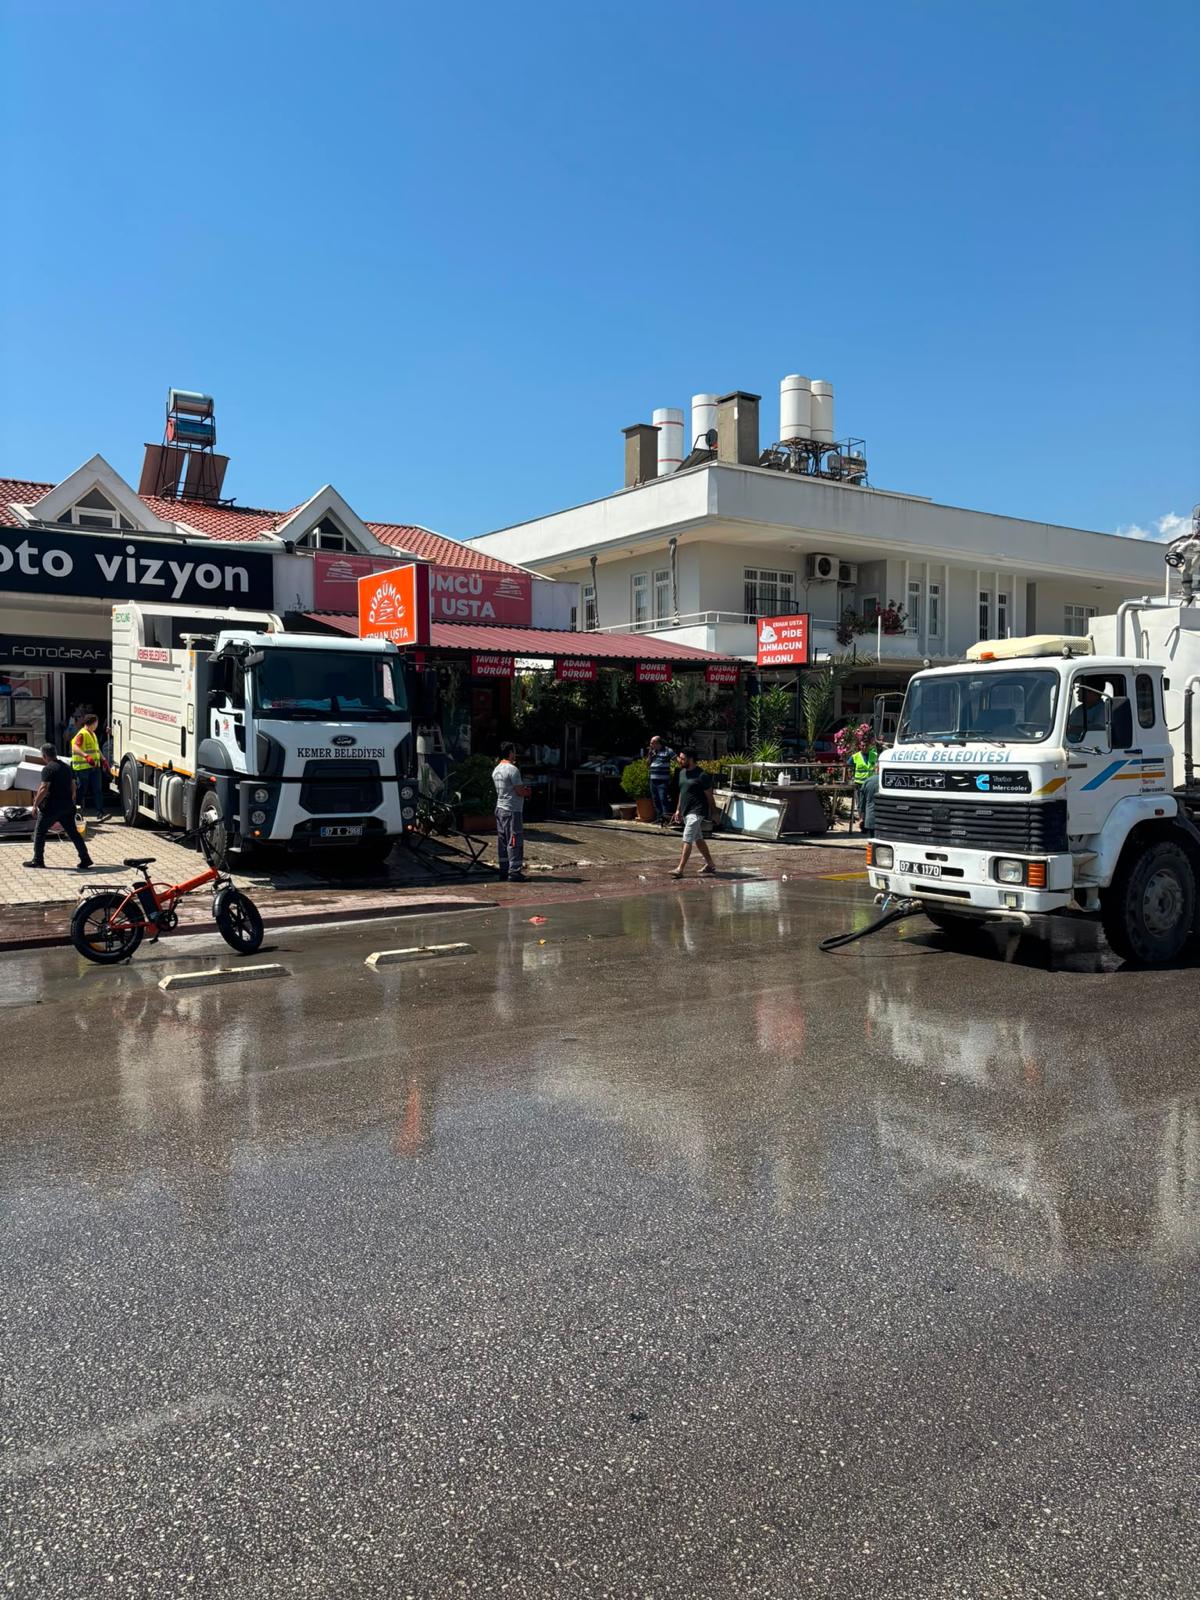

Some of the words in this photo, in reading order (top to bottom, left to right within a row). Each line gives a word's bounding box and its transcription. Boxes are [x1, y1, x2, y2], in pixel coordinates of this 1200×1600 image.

[95, 545, 249, 599] vizyon
[442, 598, 496, 618] USTA
[390, 627, 409, 639] USTA
[782, 628, 803, 638] PİDE
[759, 641, 802, 652] LAHMACUN
[12, 646, 105, 660] FOTOĞRAF
[476, 655, 499, 664] TAVUK
[563, 659, 591, 668] ADANA
[762, 654, 793, 664] SALONU
[477, 665, 511, 676] DÜRÜM
[562, 668, 593, 679] DÜRÜM
[639, 671, 668, 681] DÜRÜM
[710, 673, 736, 683] DÜRÜM
[297, 747, 332, 758] KEMER
[334, 746, 385, 758] BELEDİYESİ
[891, 750, 928, 761] KEMER
[900, 861, 909, 872] 07
[912, 863, 919, 873] K
[921, 864, 940, 876] 1170
